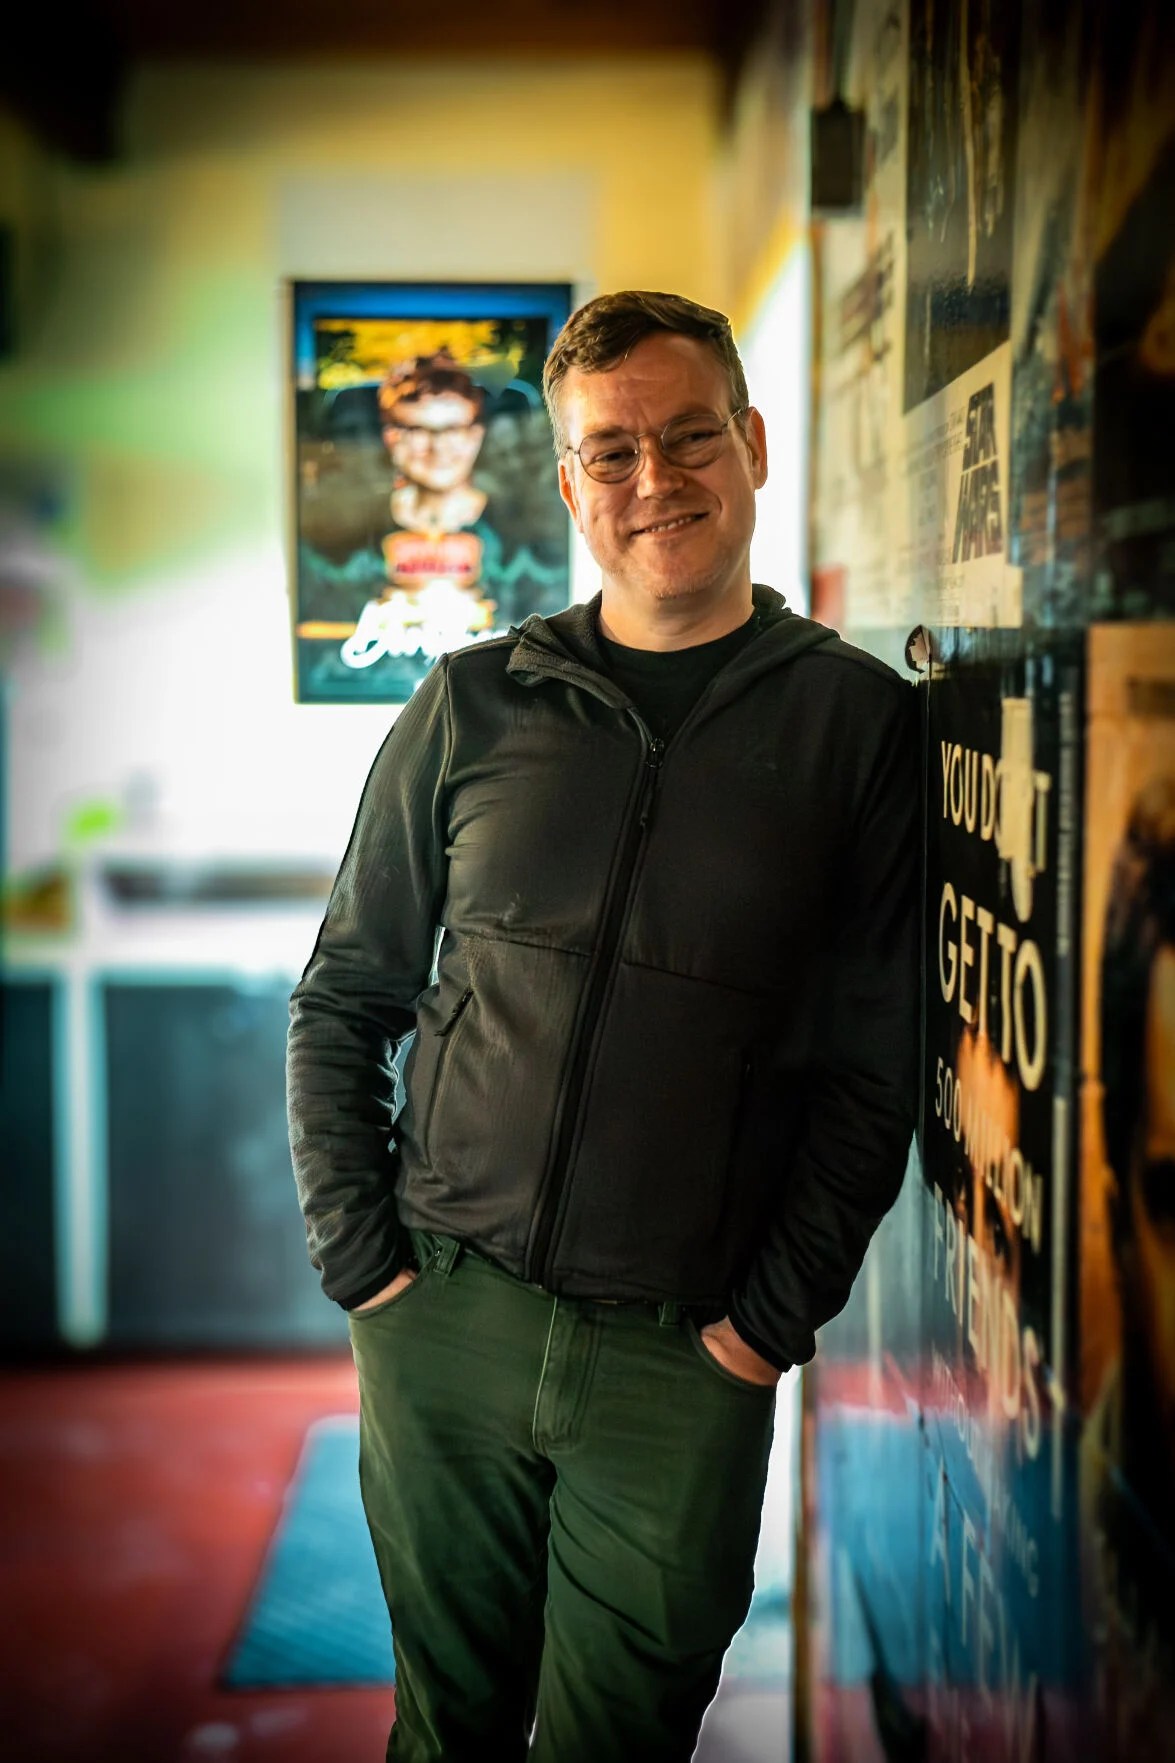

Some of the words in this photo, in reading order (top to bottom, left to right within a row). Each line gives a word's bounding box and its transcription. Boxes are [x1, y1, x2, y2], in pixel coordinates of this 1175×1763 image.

[963, 382, 998, 472] STAR
[952, 456, 1004, 563] WARS
[941, 740, 978, 834] YOU
[939, 881, 994, 1034] GET
[997, 922, 1047, 1091] TO
[935, 1056, 962, 1144] 500
[933, 1181, 1040, 1459] FRIENDS
